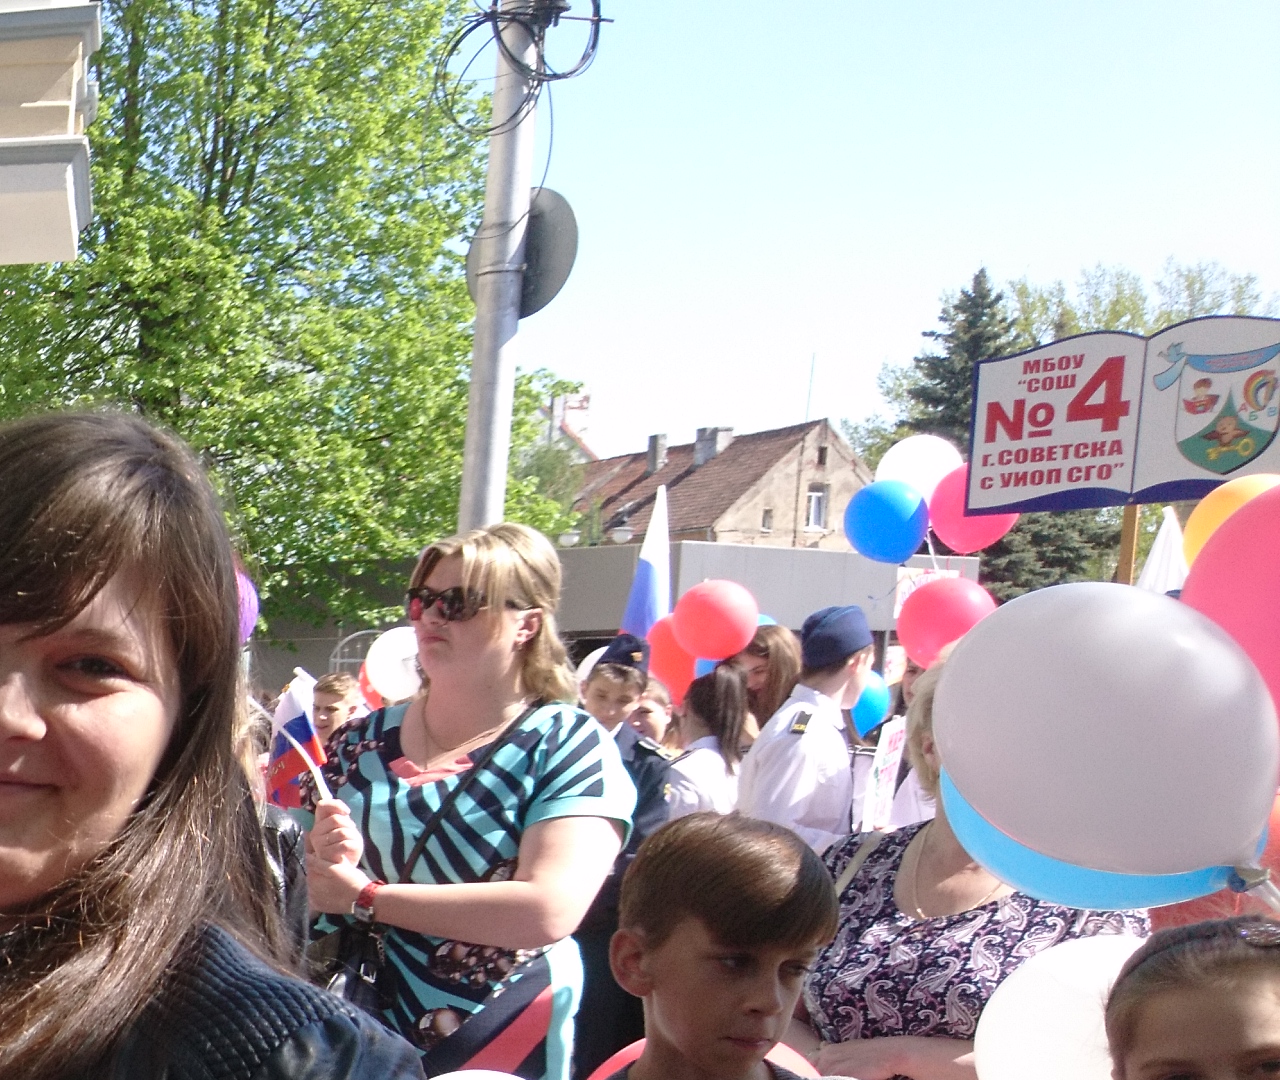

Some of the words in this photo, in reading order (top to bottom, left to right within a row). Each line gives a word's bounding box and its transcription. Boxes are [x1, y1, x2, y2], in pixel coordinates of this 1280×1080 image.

[1022, 354, 1085, 375] МБОУ
[1066, 355, 1130, 432] 4
[1000, 468, 1062, 488] УИОП
